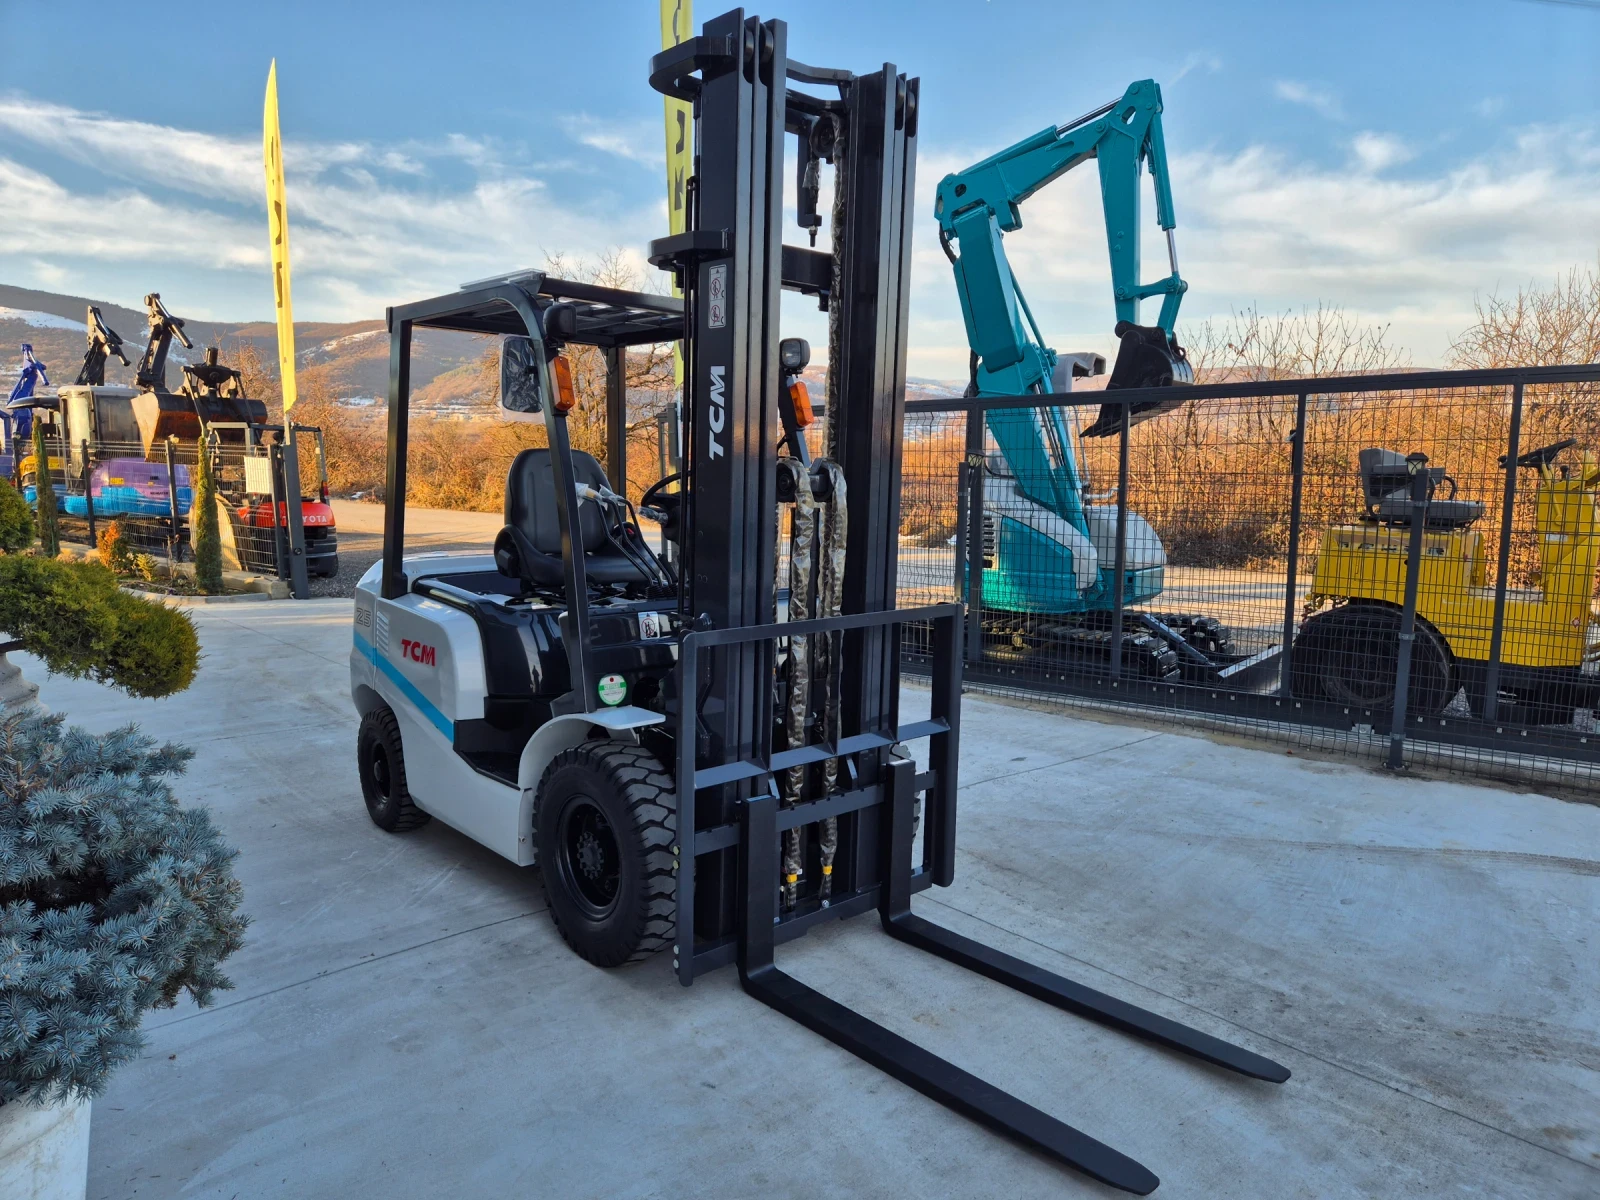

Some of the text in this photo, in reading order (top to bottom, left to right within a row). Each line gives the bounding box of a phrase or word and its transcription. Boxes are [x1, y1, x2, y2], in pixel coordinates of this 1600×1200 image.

[709, 365, 725, 460] TCM
[356, 607, 371, 628] 25
[401, 638, 436, 667] TCM
